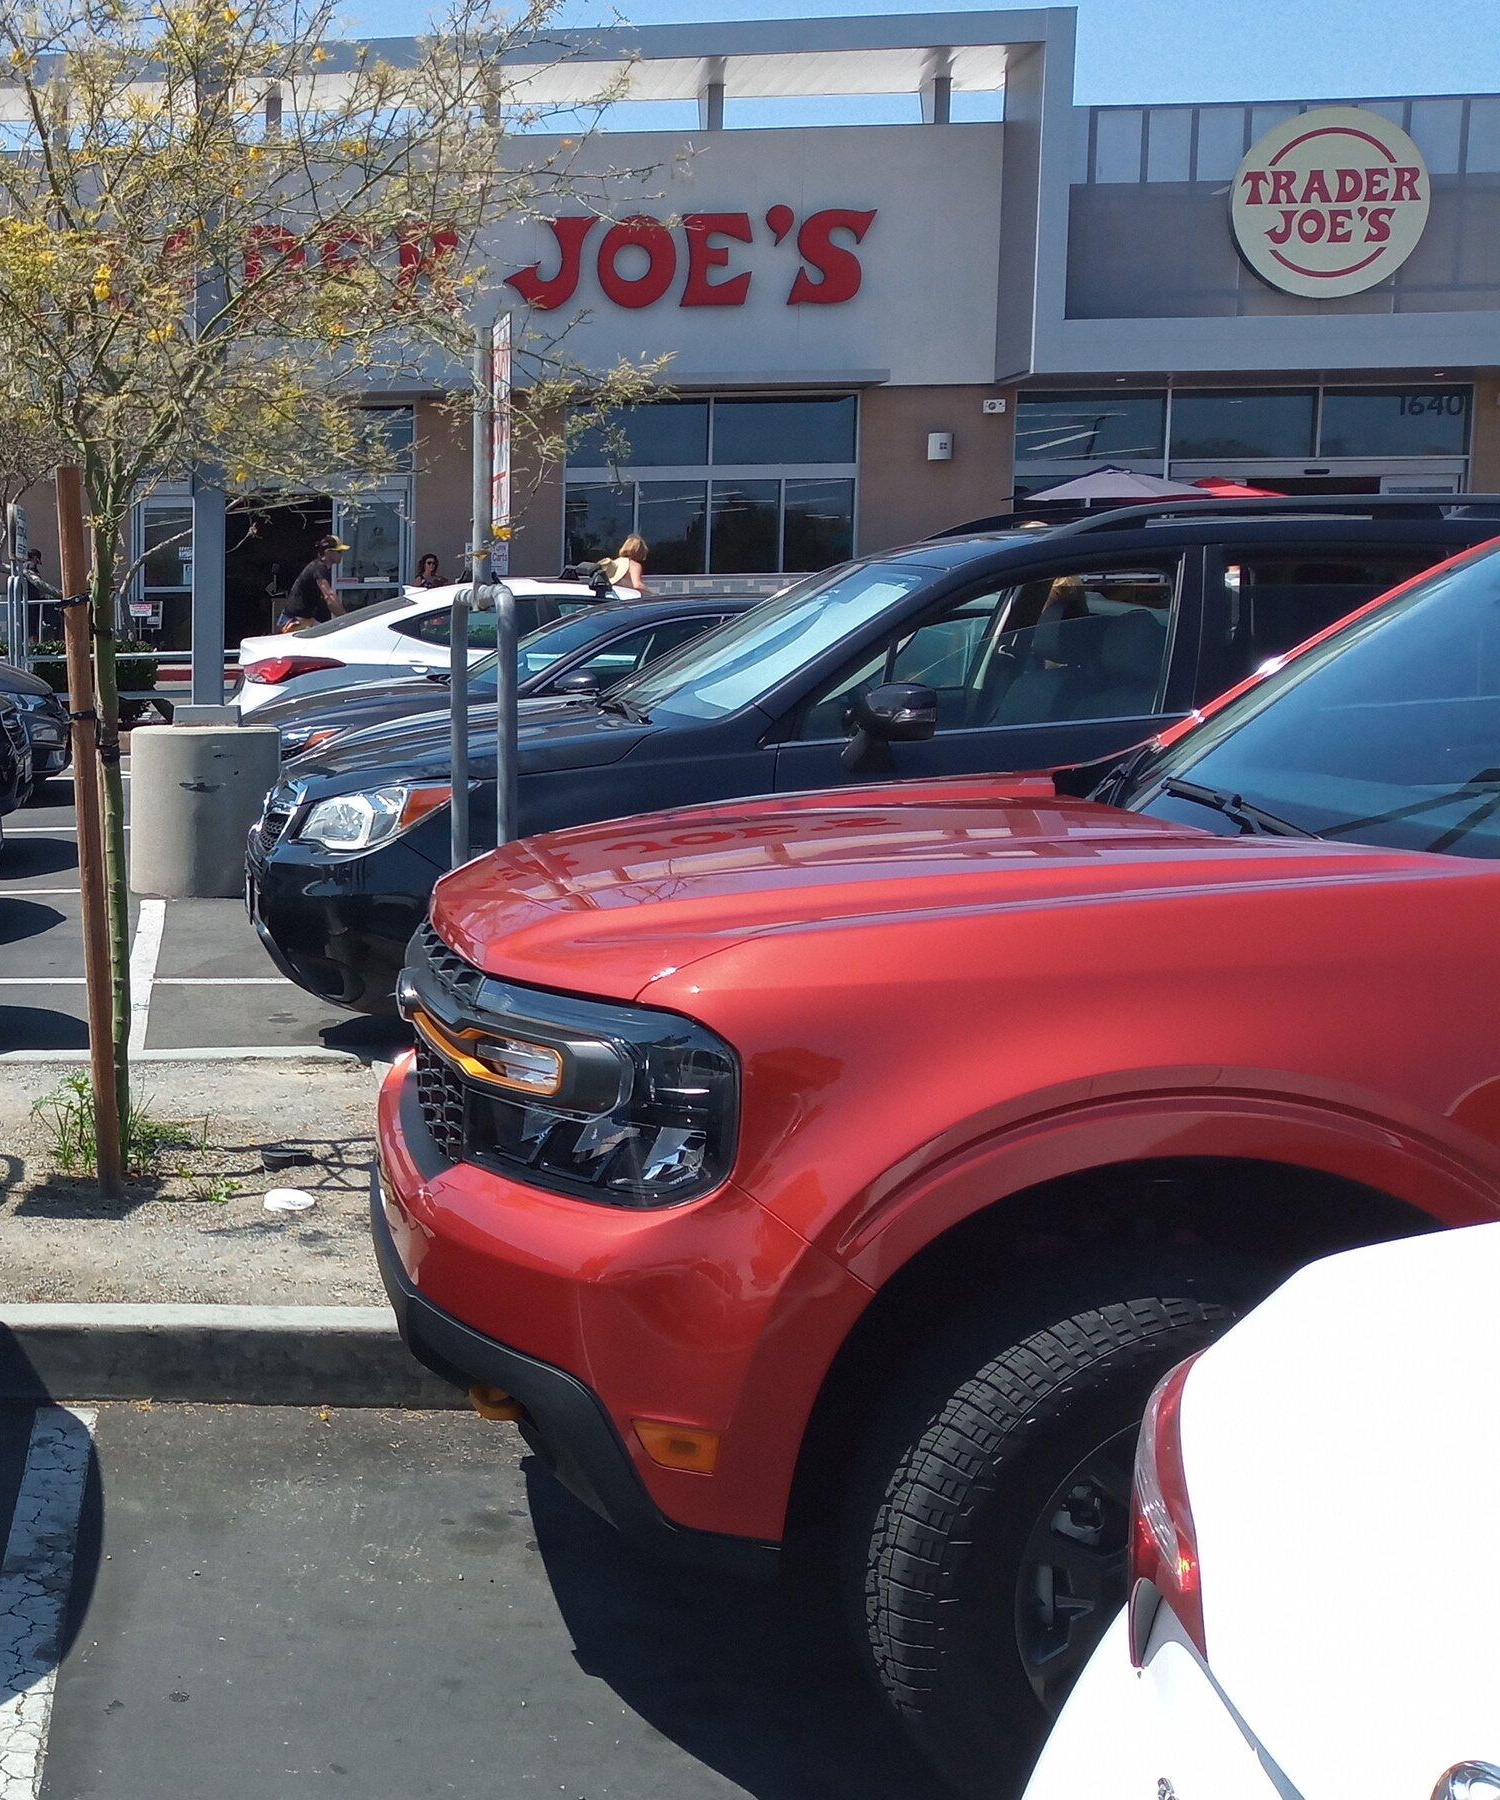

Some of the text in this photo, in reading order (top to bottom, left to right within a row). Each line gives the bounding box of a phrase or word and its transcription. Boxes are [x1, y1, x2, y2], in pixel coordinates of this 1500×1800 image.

[1241, 166, 1422, 206] TRADER
[1264, 207, 1397, 245] JOE'S
[503, 204, 878, 310] JOE'S
[1399, 394, 1464, 416] 1640
